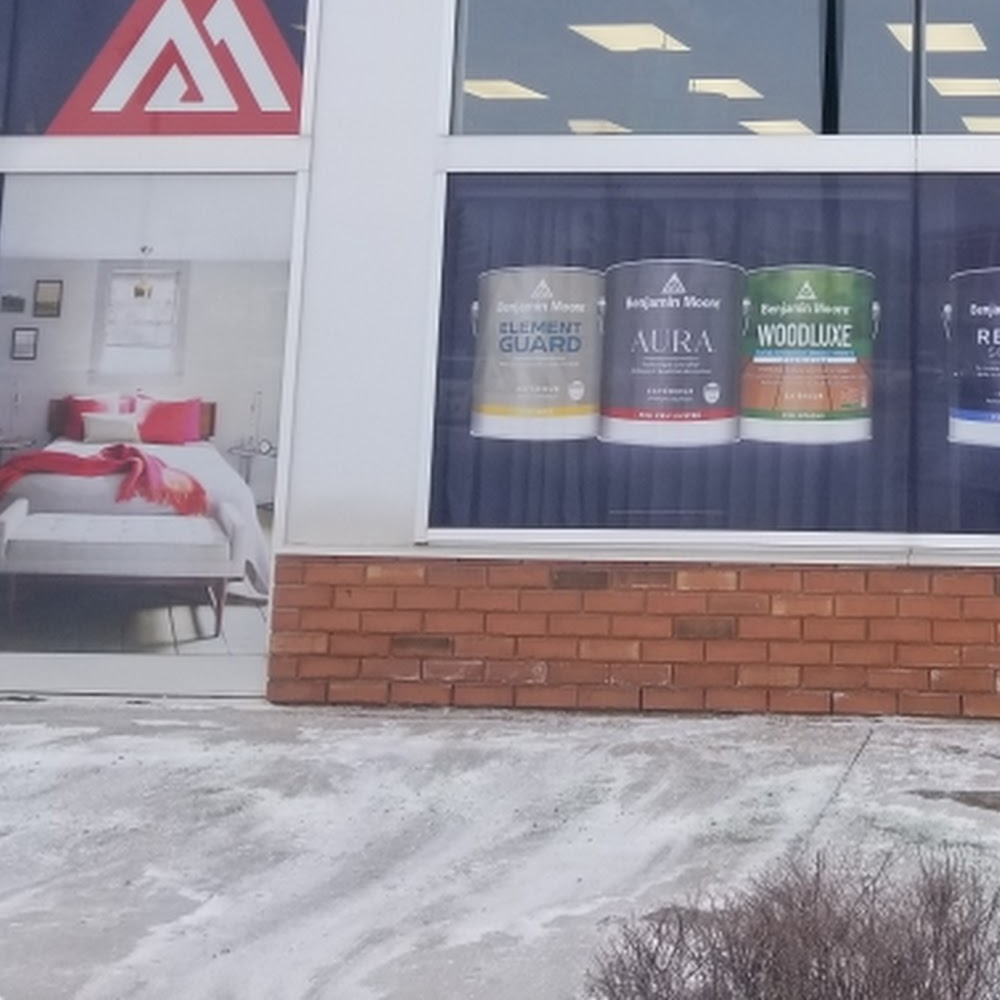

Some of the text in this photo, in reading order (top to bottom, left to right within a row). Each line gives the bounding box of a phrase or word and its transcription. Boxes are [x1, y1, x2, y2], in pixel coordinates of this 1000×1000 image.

[626, 296, 681, 311] Benjamin
[498, 321, 583, 334] ELEMENT
[757, 324, 853, 347] WOODLUXE
[498, 336, 583, 354] GUARD
[631, 329, 717, 353] AURA
